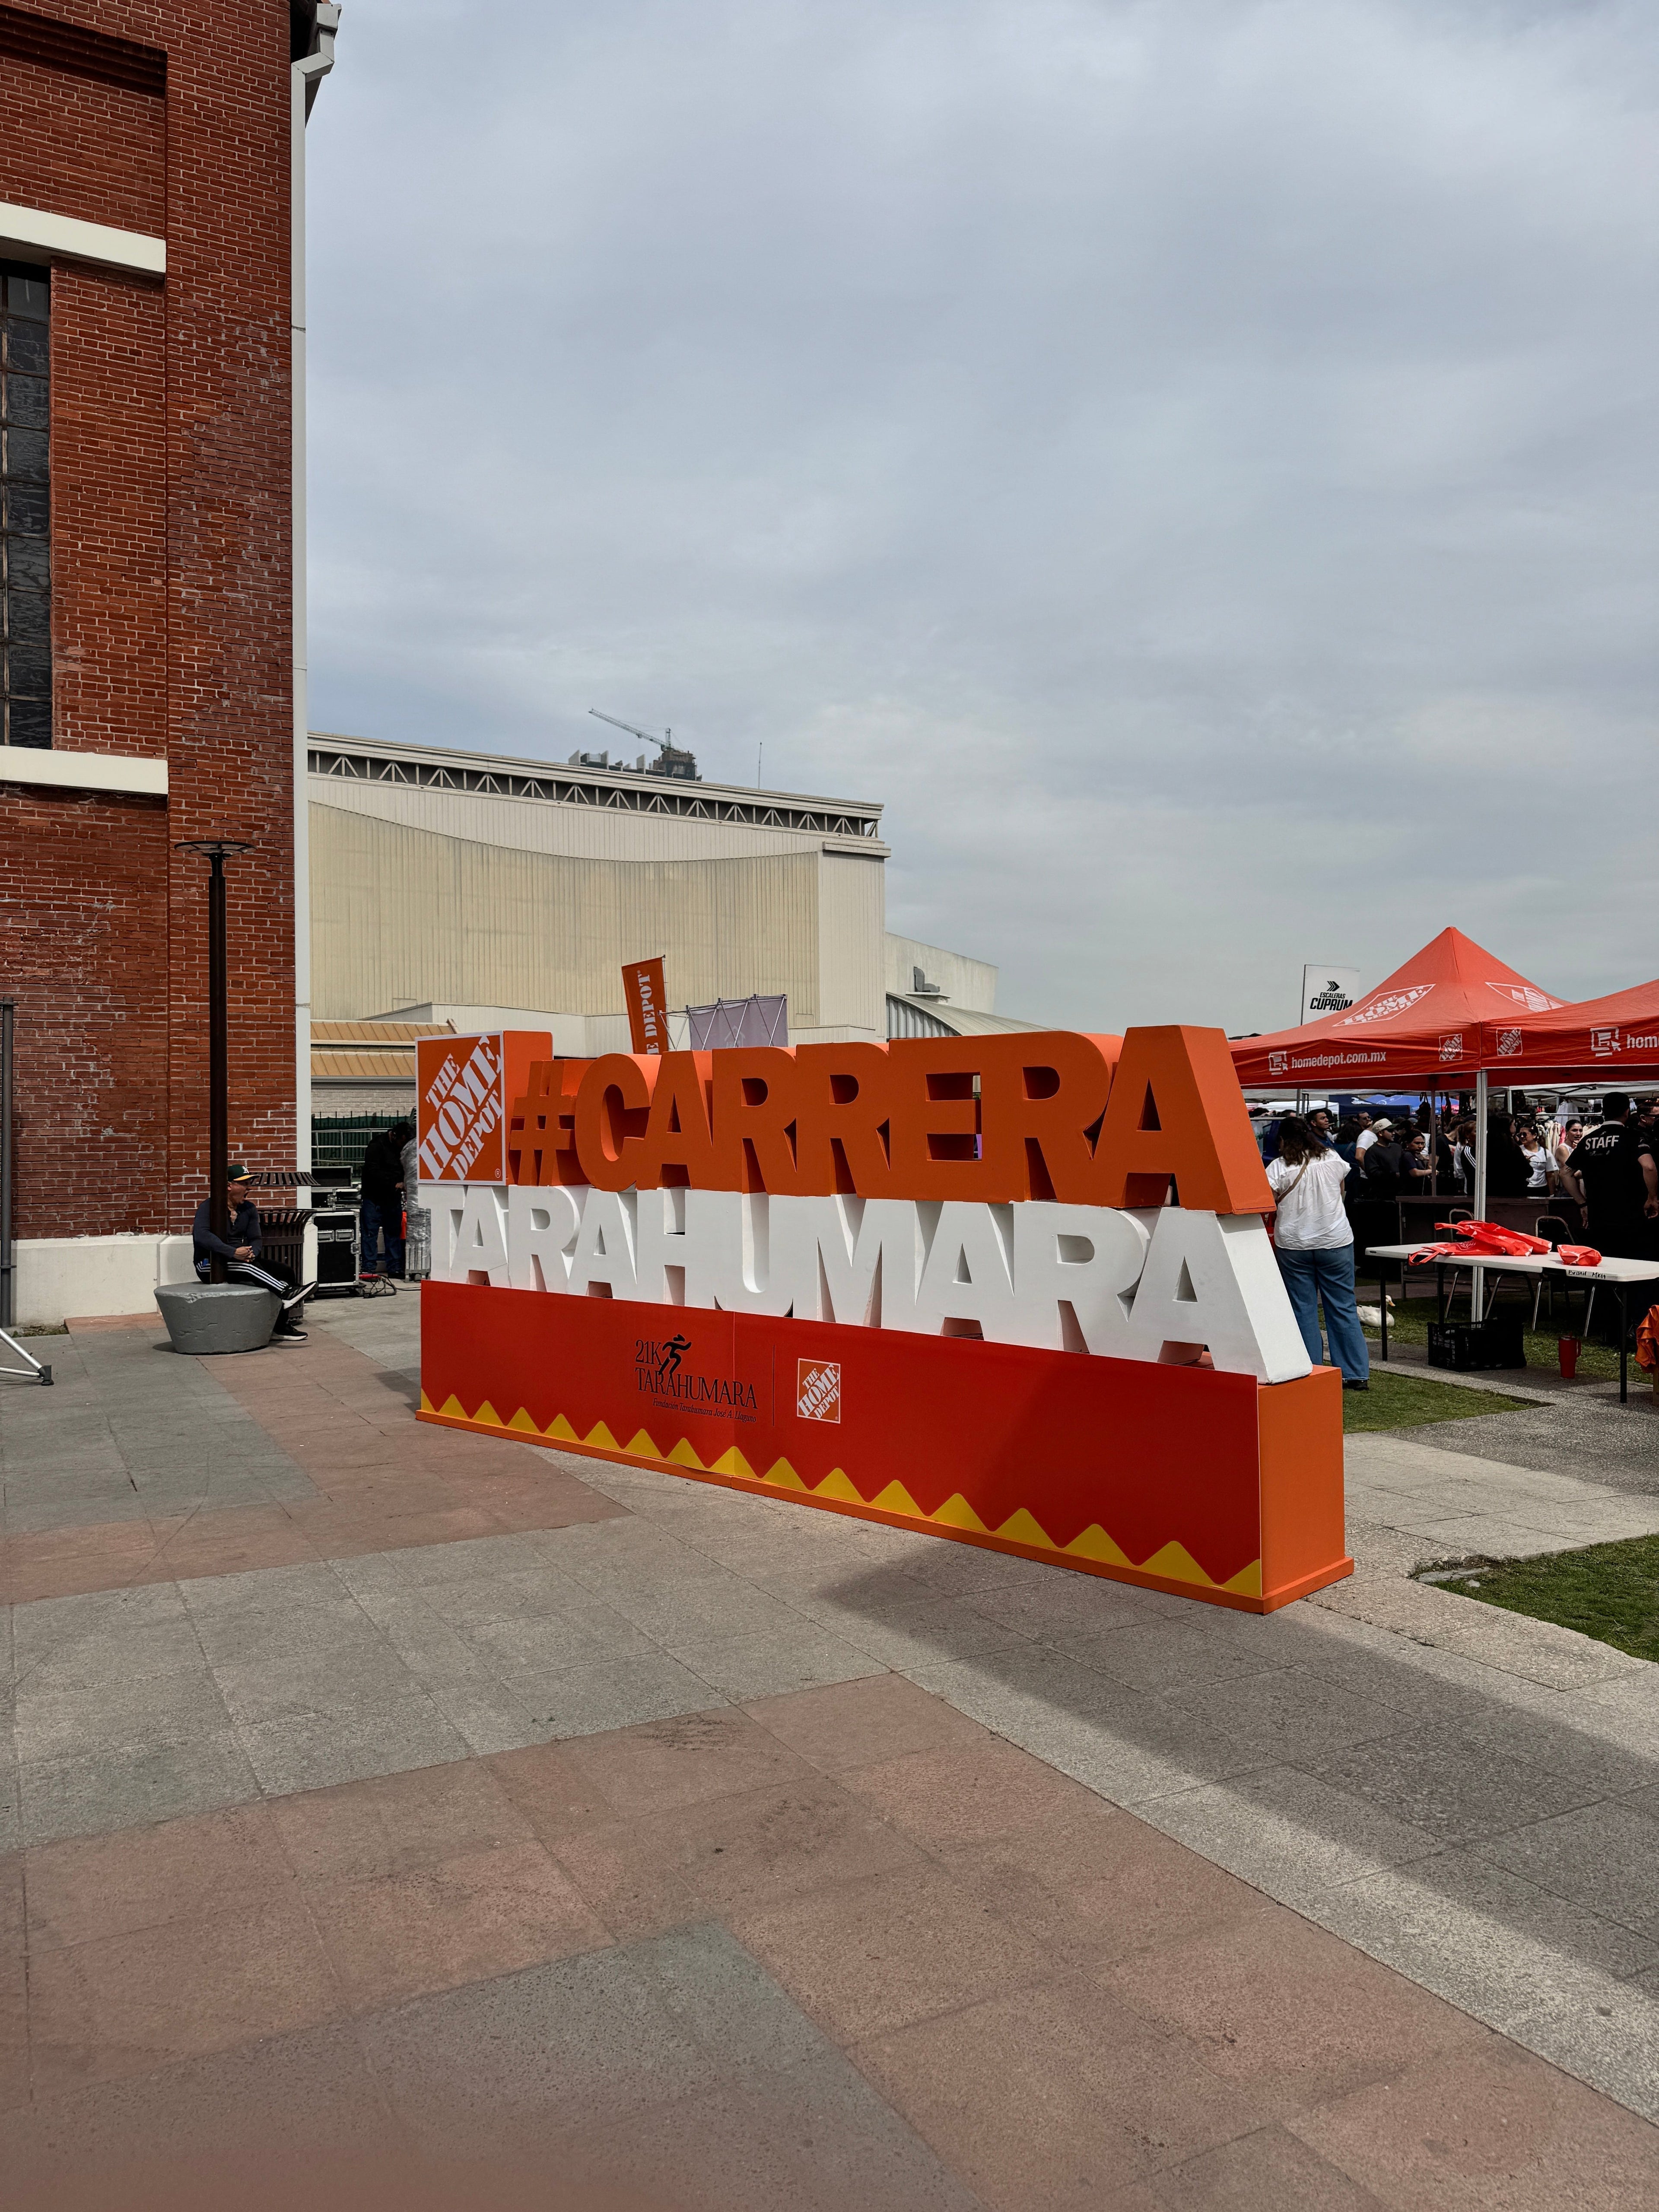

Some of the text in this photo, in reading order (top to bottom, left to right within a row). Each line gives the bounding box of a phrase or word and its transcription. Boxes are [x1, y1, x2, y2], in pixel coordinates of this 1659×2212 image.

[638, 974, 657, 1038] DEPOT
[1291, 1051, 1386, 1068] homedepot.com.mx
[1627, 1034, 1659, 1049] hom
[425, 1053, 461, 1111] THE
[418, 1036, 501, 1180] HOME
[509, 1025, 1249, 1215] #CARRERA
[451, 1089, 502, 1180] DEPOT
[1585, 1135, 1620, 1150] STAFF
[417, 1184, 1281, 1384] TARAHUMARA
[635, 1339, 663, 1367] 21K
[635, 1367, 758, 1409] TARAHUMARA
[798, 1363, 839, 1417] HOME
[802, 1368, 820, 1389] THE
[653, 1398, 679, 1411] Fundación
[680, 1402, 712, 1416] Tarahumara
[713, 1408, 726, 1418] José
[734, 1411, 756, 1423] Llaguno
[814, 1386, 839, 1419] DEPOT
